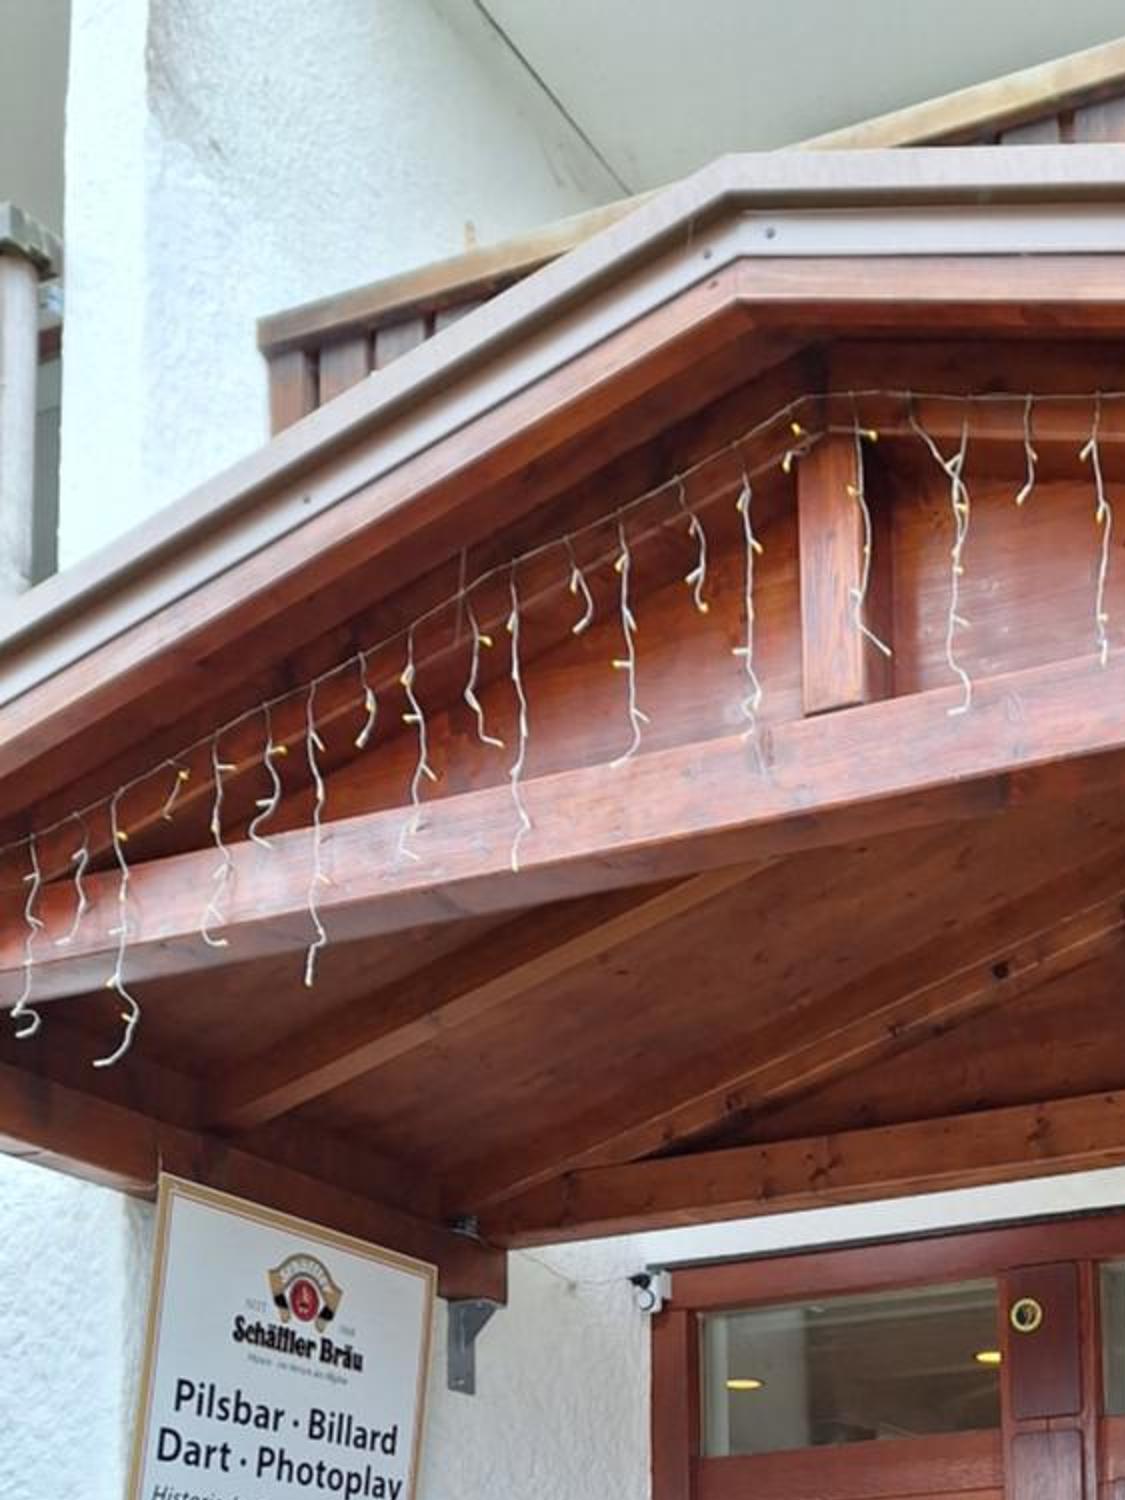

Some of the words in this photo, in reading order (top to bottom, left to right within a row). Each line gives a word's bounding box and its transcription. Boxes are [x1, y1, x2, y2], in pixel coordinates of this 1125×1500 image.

[319, 1337, 363, 1373] Bräu
[174, 1378, 285, 1432] Pilsbar
[307, 1408, 398, 1455] Billard
[156, 1427, 232, 1472] Dart
